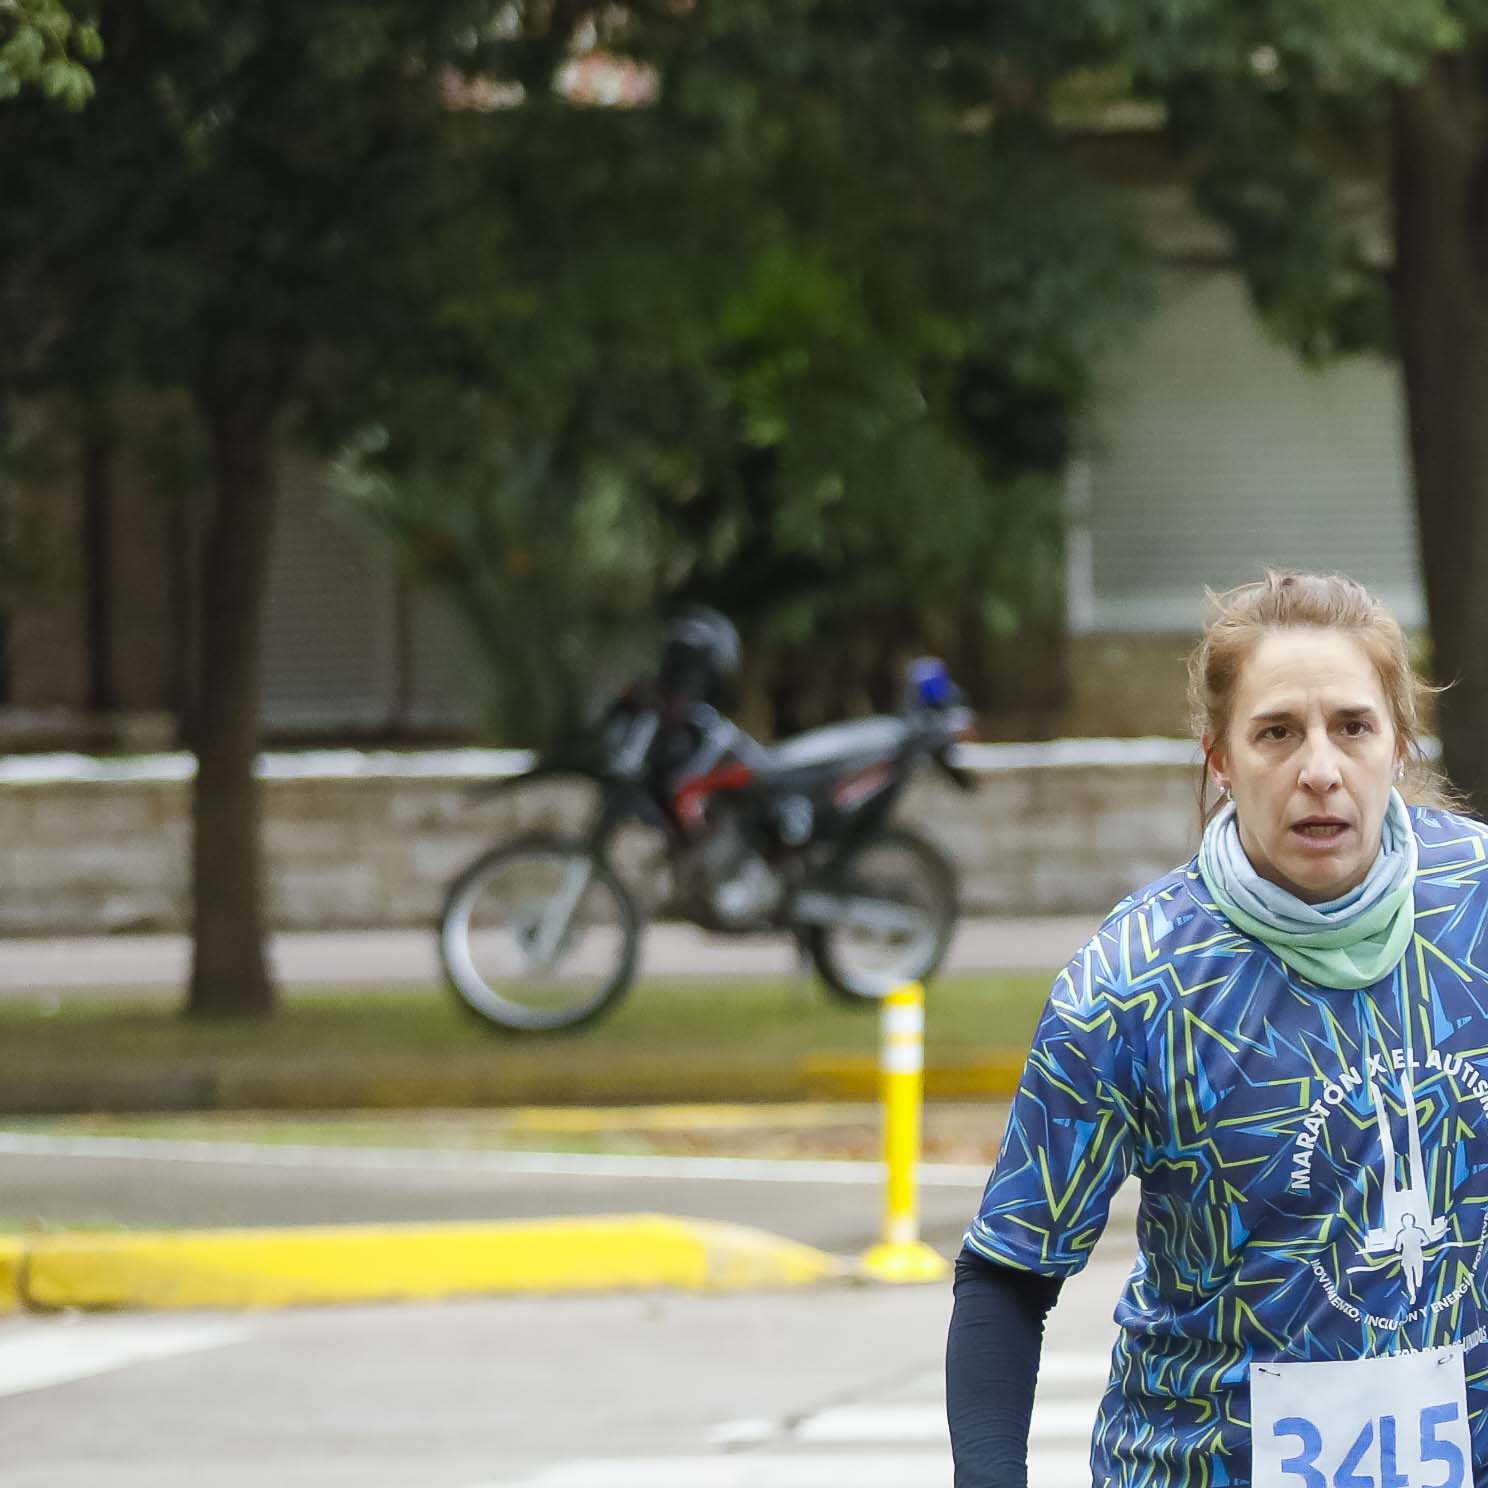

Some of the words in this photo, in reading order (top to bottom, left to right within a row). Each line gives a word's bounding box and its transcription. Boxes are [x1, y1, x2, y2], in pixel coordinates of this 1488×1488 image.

[1290, 1066, 1363, 1190] MARATÓN
[1366, 1053, 1388, 1077] X
[1391, 1048, 1420, 1069] EL
